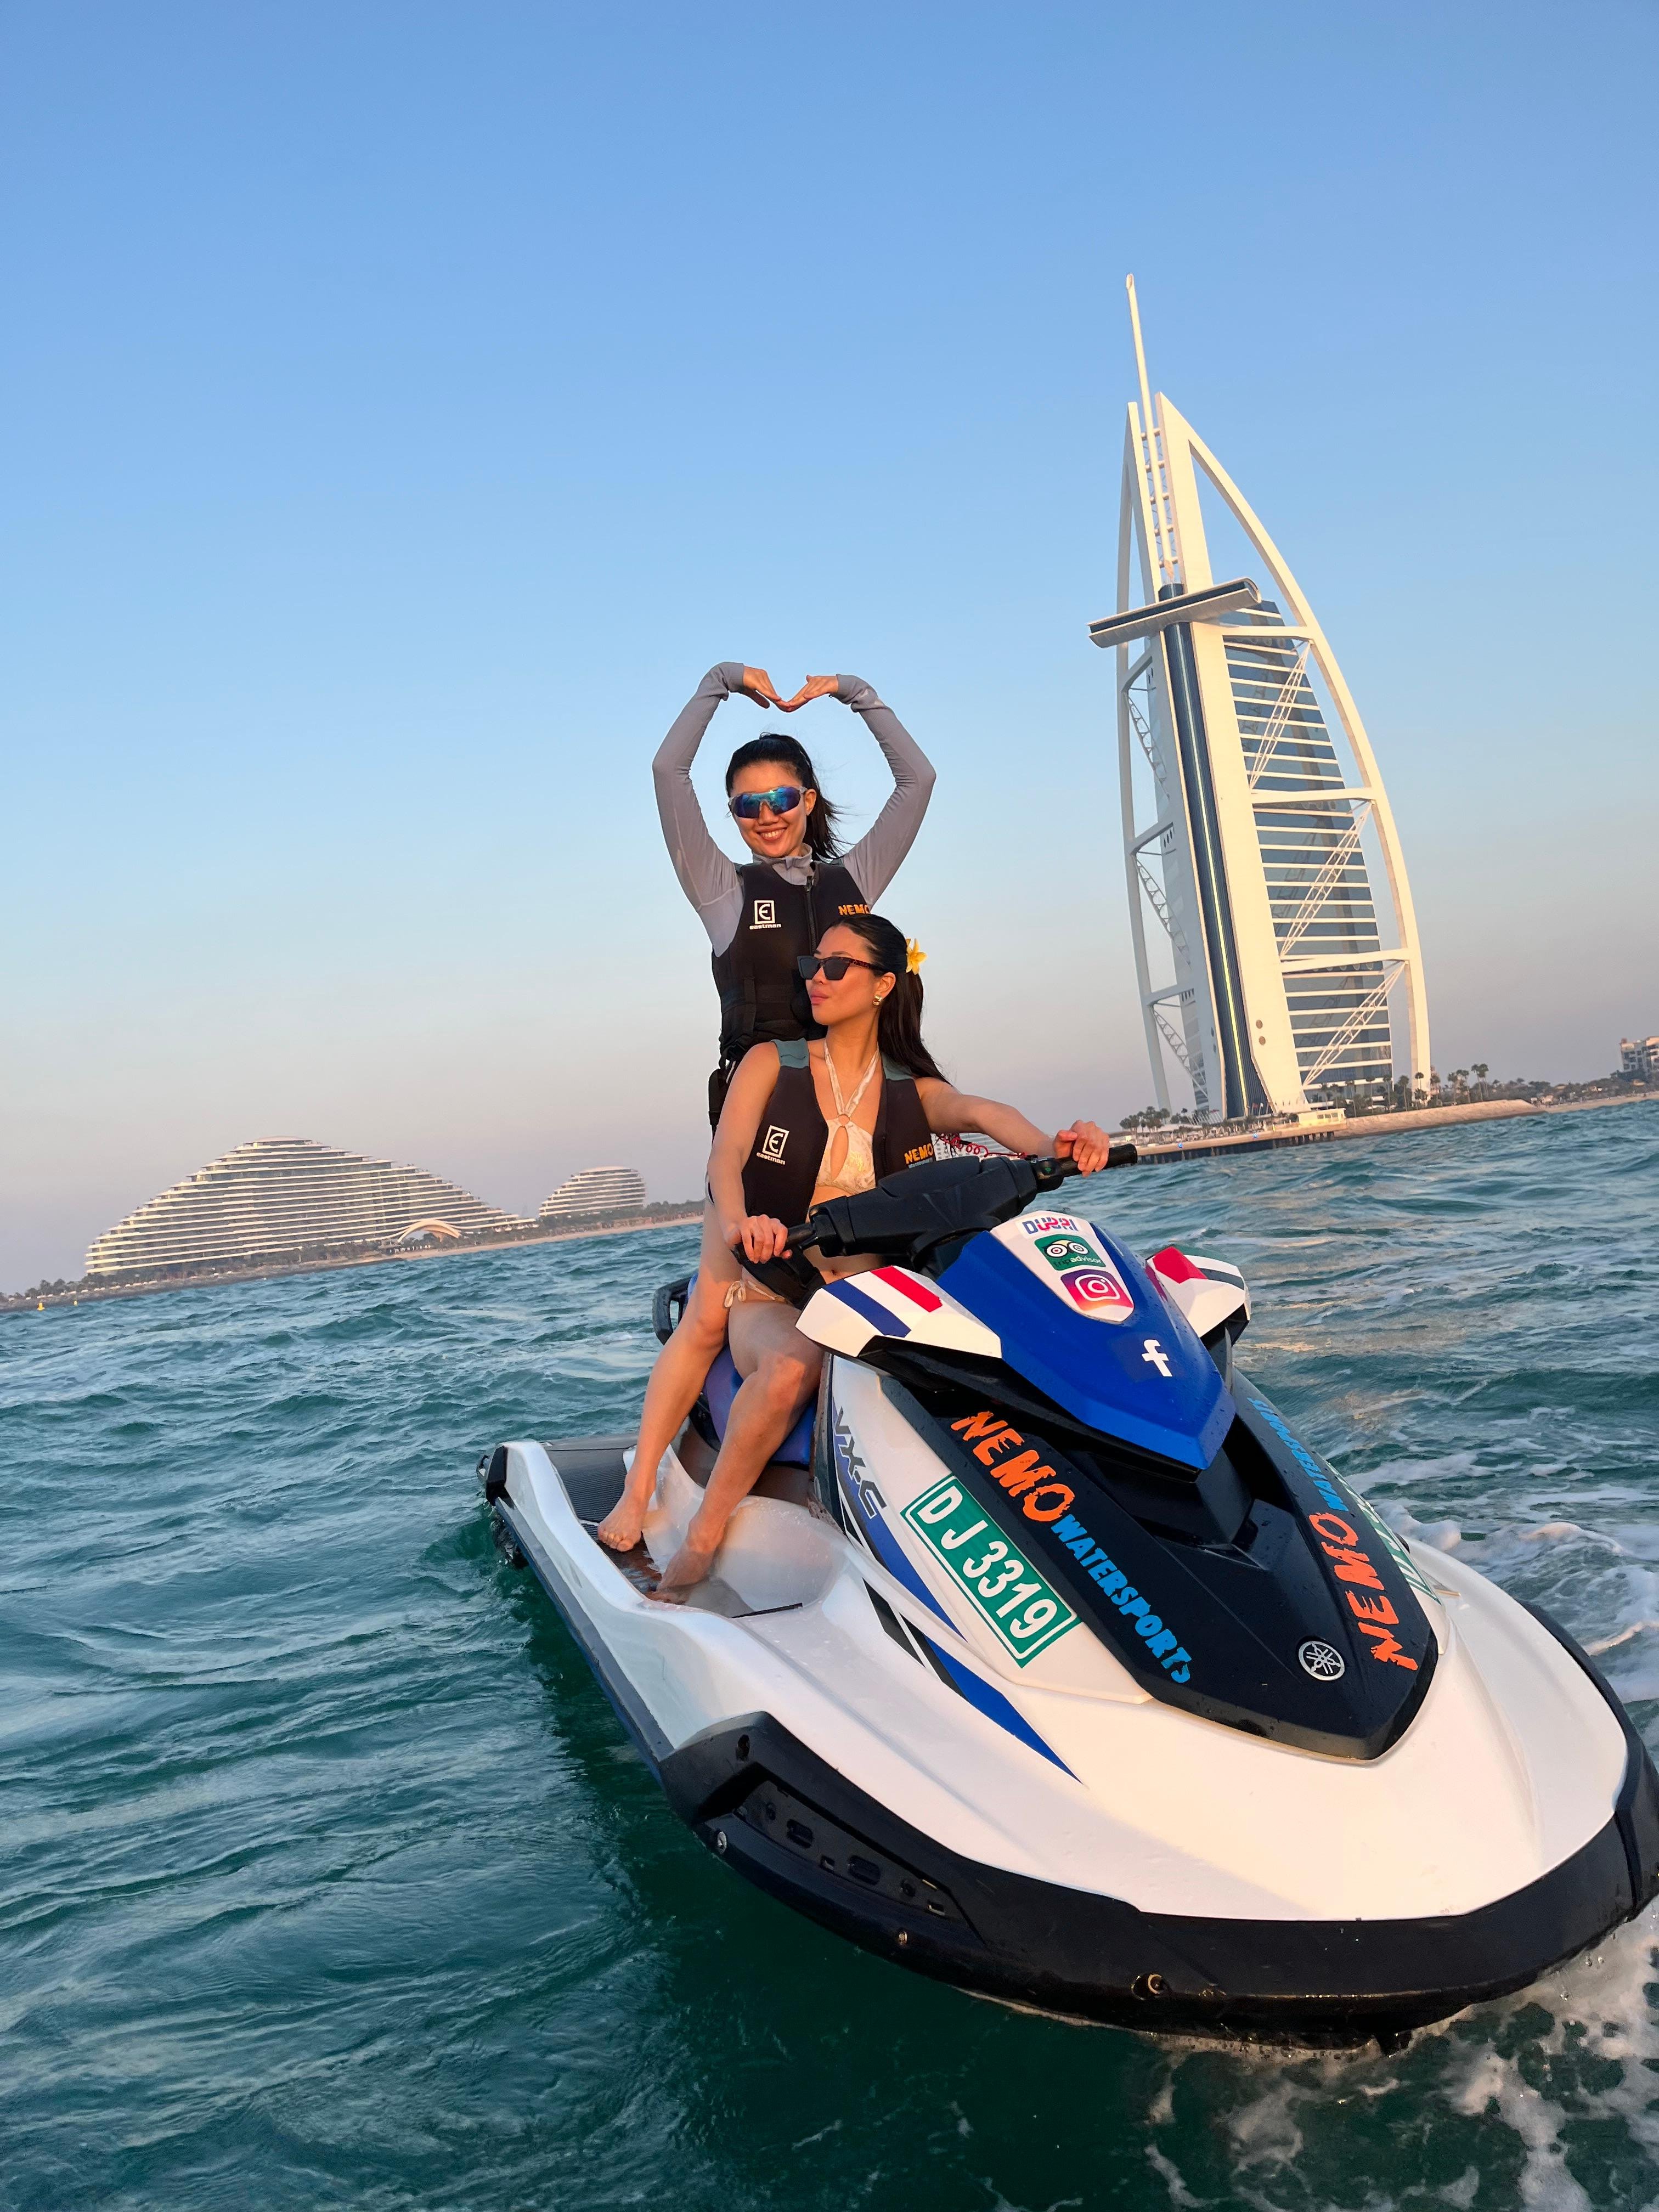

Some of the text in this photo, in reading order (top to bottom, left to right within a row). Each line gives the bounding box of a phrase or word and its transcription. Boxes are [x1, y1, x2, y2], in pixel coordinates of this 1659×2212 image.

[757, 1152, 785, 1165] eastman
[904, 1143, 933, 1164] NEMO
[1054, 1256, 1102, 1267] tripadvisor
[951, 1410, 1192, 1684] NEMO WATERSPORTS
[963, 1541, 1057, 1638] 3319
[1309, 1513, 1418, 1671] NEMO
